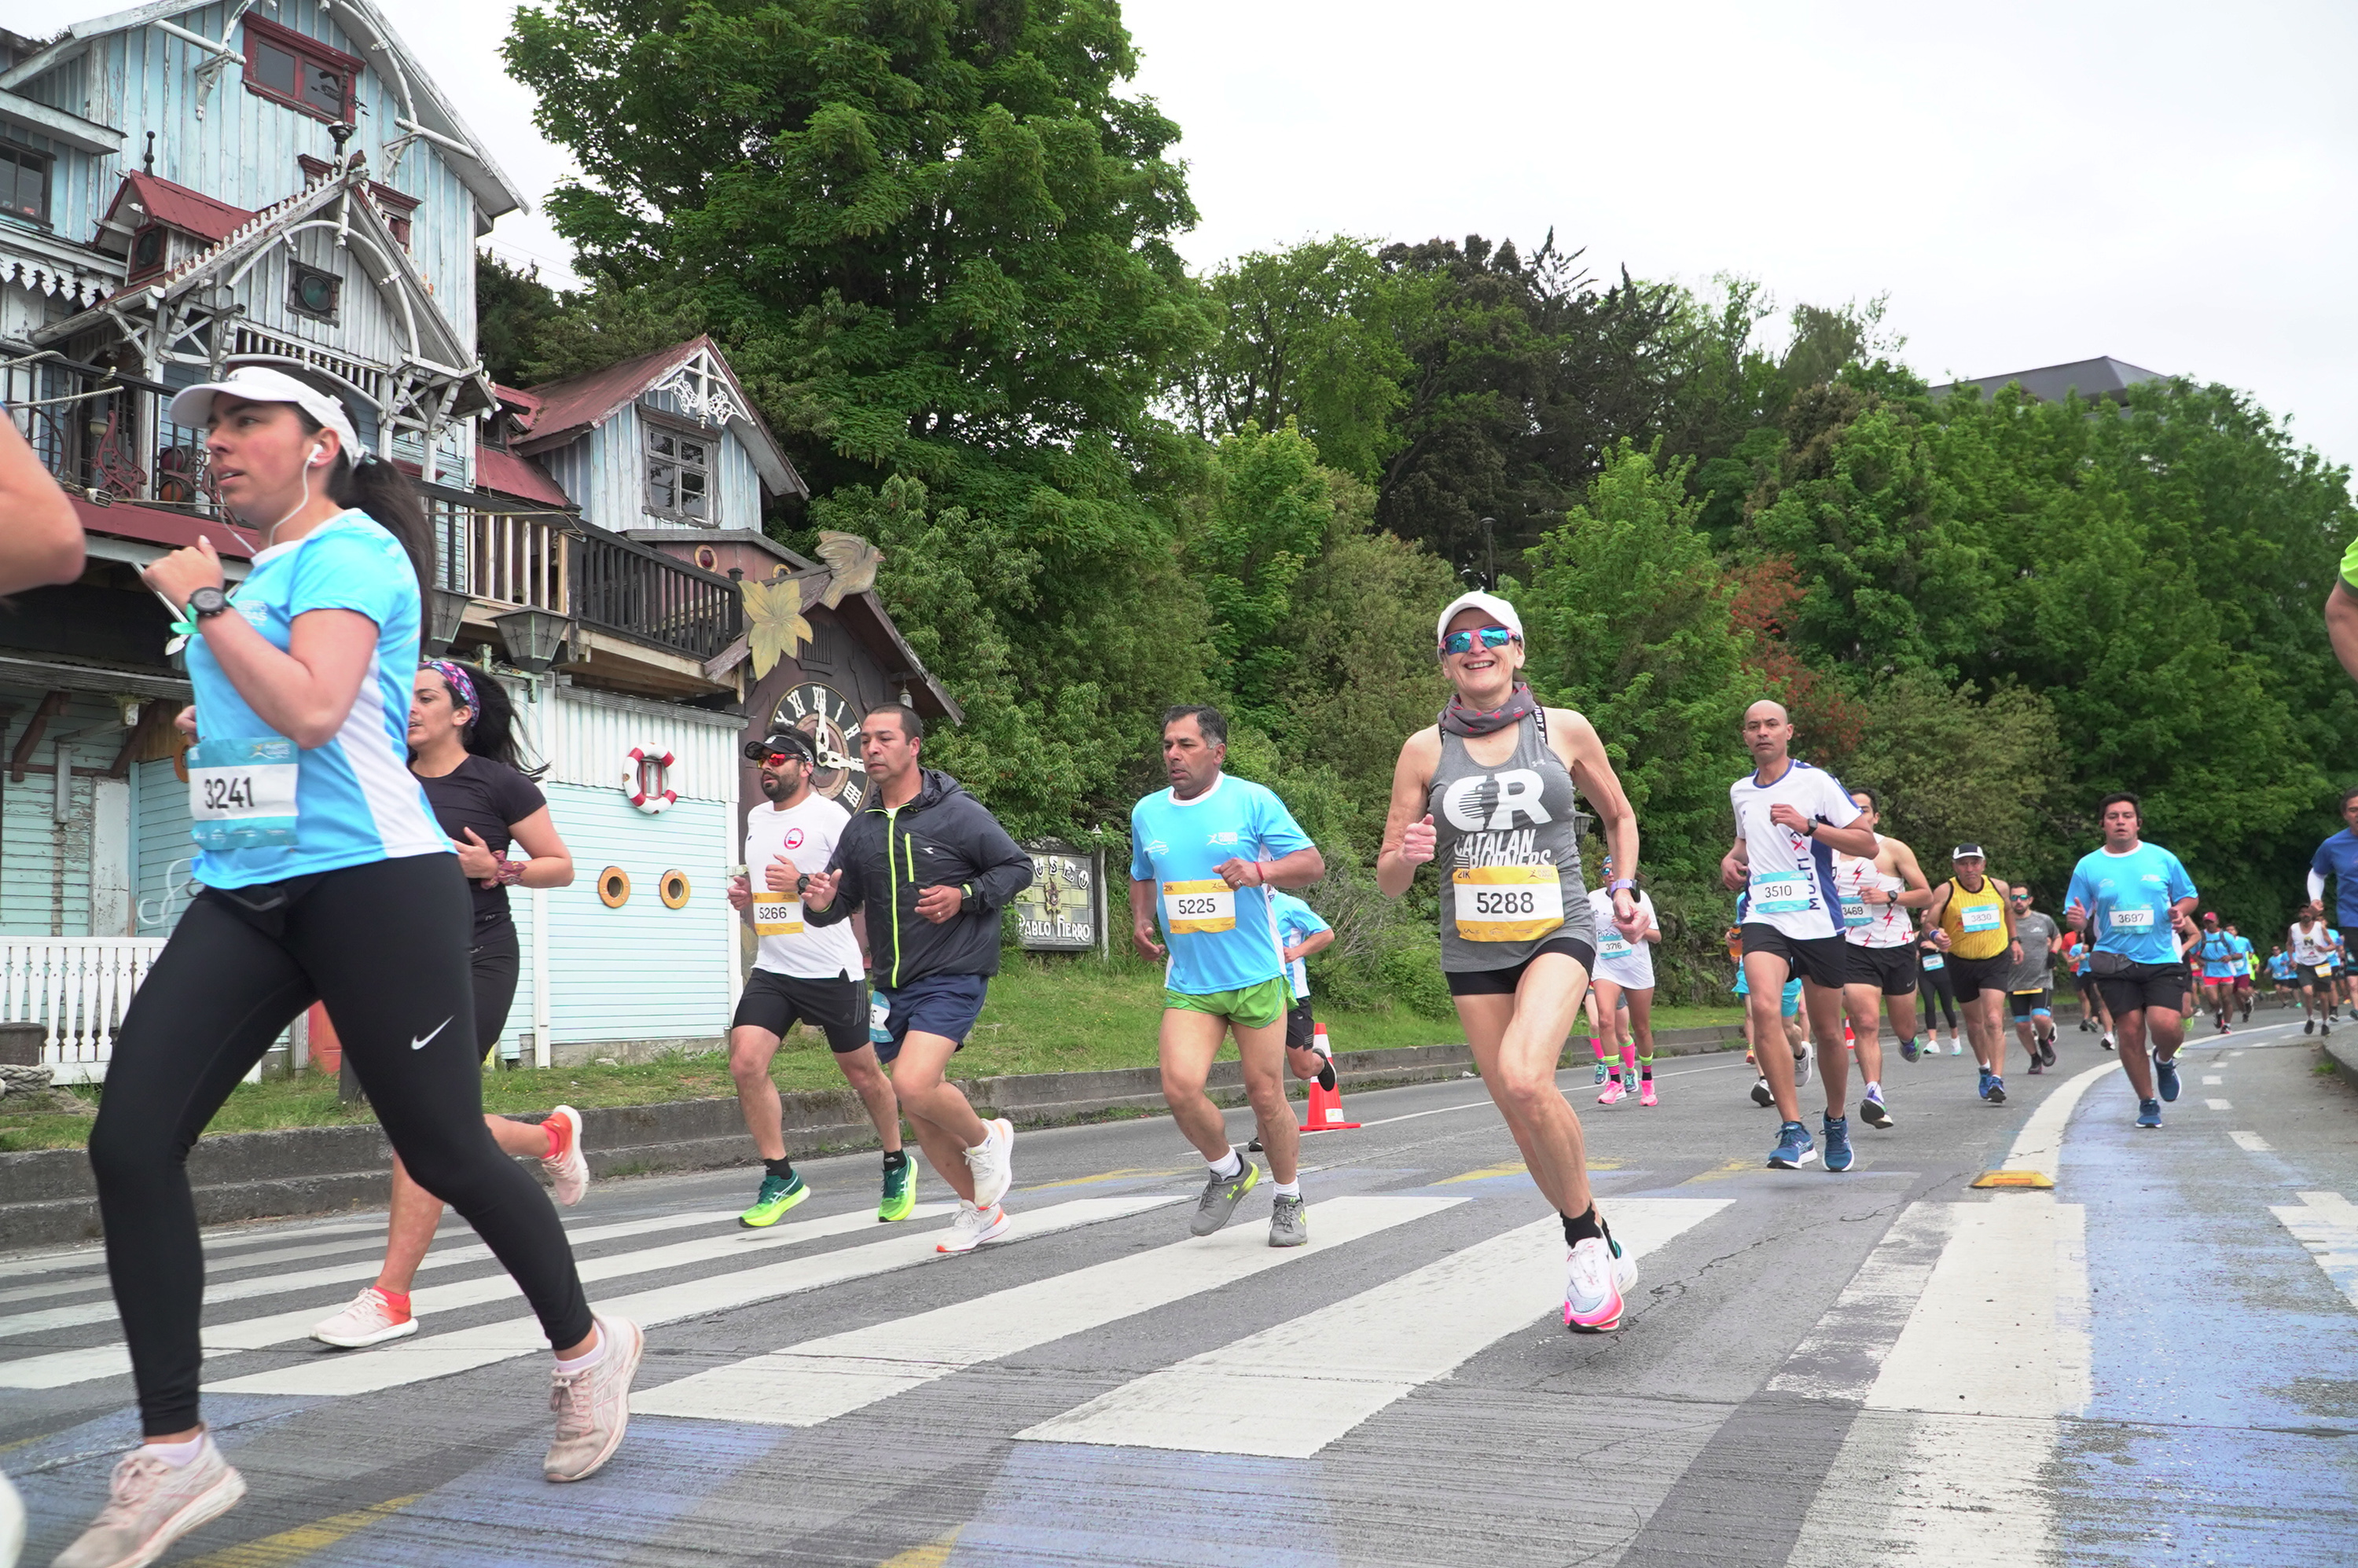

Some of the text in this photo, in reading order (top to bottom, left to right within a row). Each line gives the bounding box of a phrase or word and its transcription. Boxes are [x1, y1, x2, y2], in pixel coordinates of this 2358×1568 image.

[204, 777, 255, 810] 3241
[1454, 828, 1537, 858] CATALAN
[1033, 855, 1089, 890] USEO
[1765, 885, 1792, 898] 3510
[1178, 898, 1216, 915] 5225
[1476, 891, 1535, 914] 5288
[1842, 906, 1864, 916] 3469
[758, 906, 787, 920] 5266
[1971, 913, 1993, 923] 3830
[2118, 913, 2144, 924] 3697
[1018, 913, 1091, 942] PABLO FIERRO
